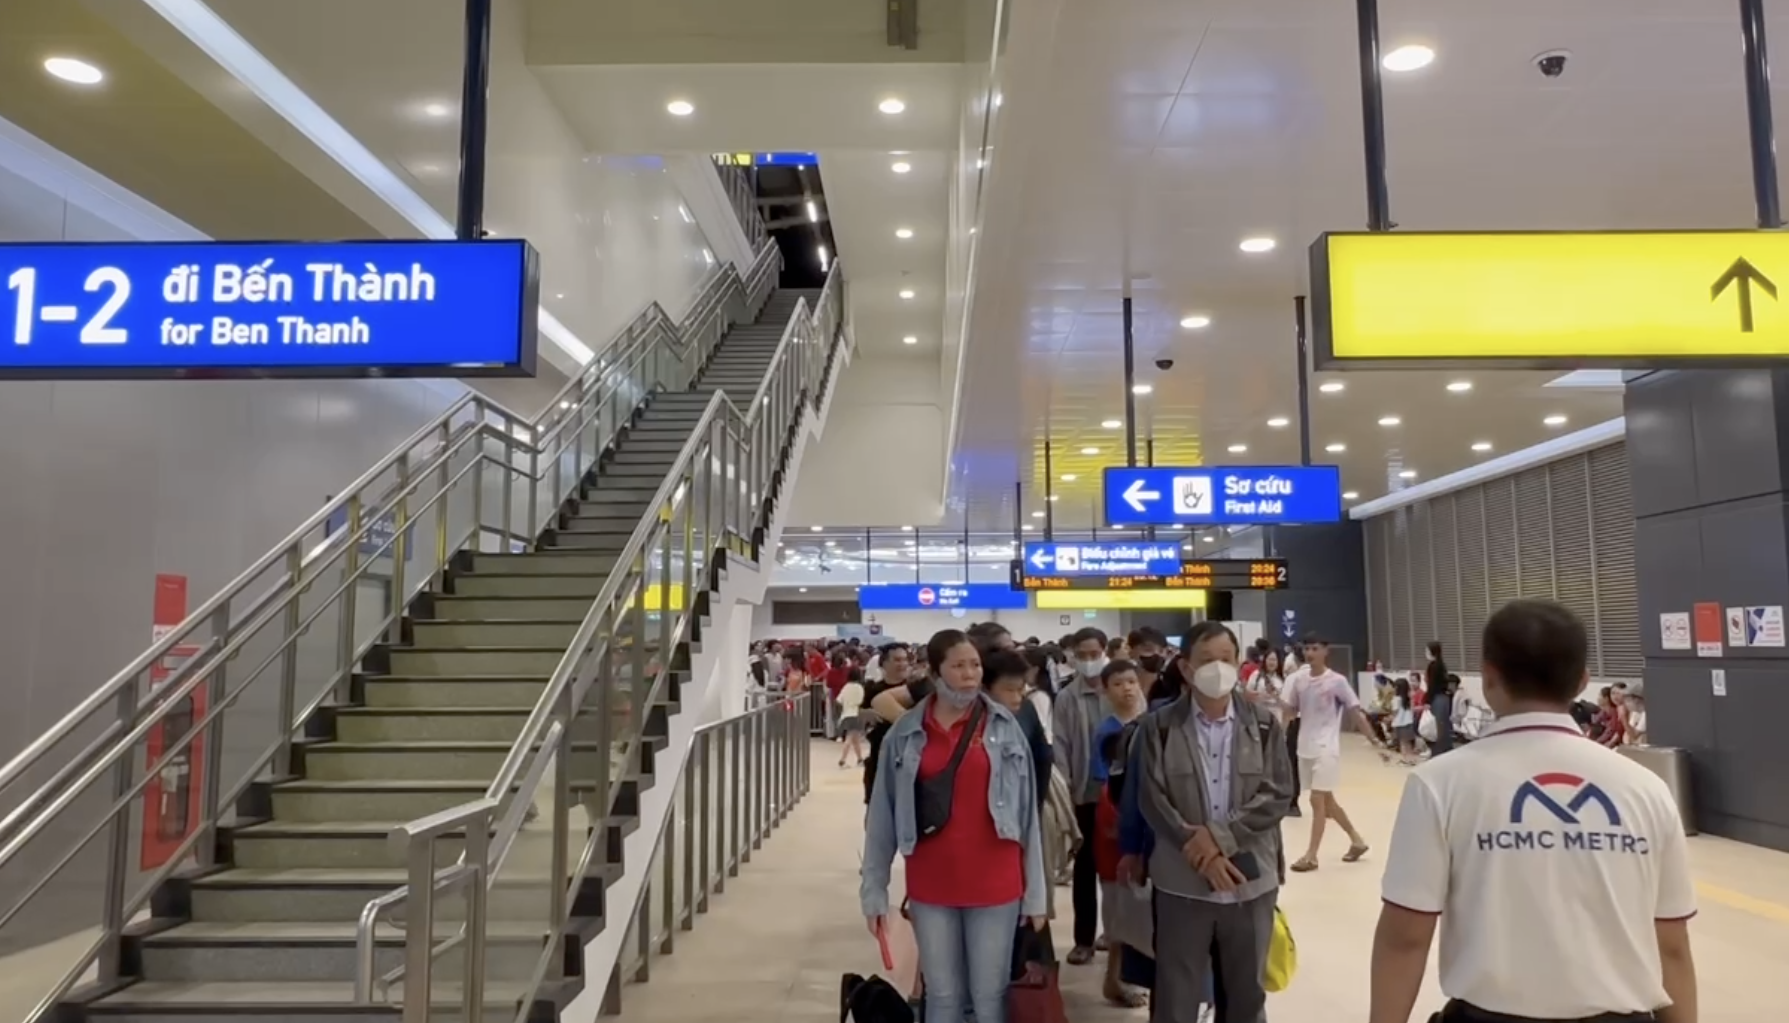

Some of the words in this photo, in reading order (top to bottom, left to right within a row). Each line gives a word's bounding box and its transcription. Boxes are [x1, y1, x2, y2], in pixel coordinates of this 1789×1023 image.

[162, 263, 199, 302] đi
[212, 258, 293, 302] Bến
[305, 263, 436, 302] Thành
[7, 266, 132, 345] 1-2
[160, 317, 203, 345] for
[211, 317, 269, 345] Ben
[277, 316, 370, 345] Thanh
[1224, 475, 1251, 495] Sơ
[1255, 474, 1293, 495] cứu
[1224, 499, 1256, 514] First
[1258, 499, 1283, 514] Aid
[1277, 566, 1288, 581] 2
[1477, 831, 1555, 851] HCMC
